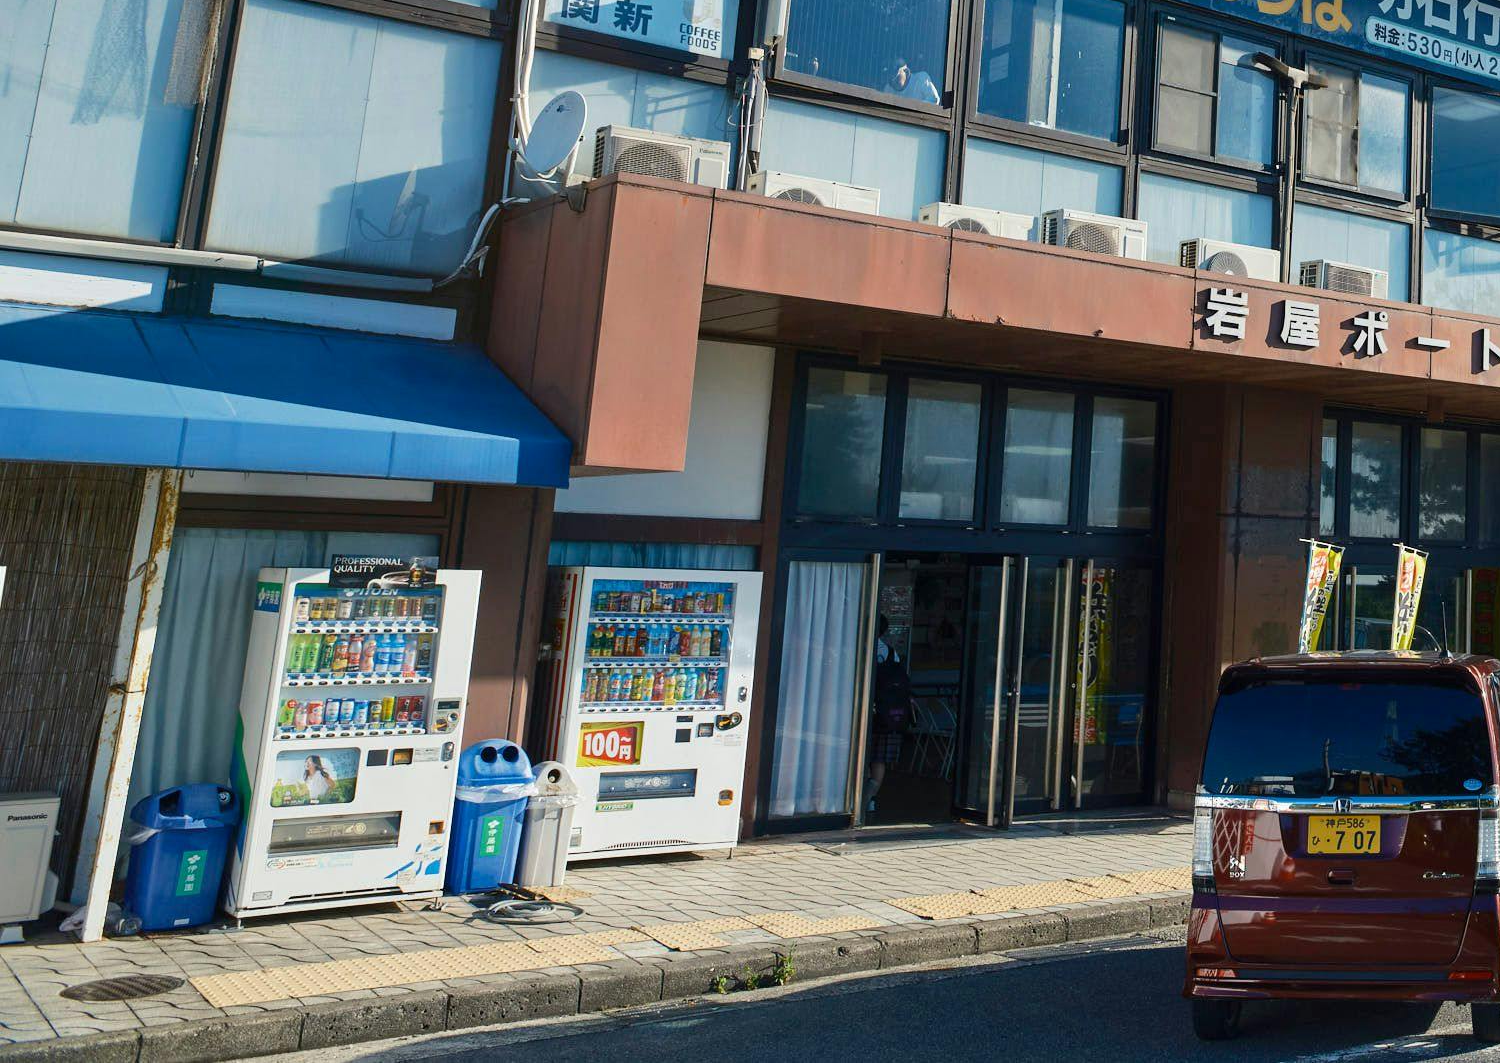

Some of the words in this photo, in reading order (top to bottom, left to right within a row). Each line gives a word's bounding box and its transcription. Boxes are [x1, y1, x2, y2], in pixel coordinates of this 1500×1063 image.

[680, 23, 721, 42] COFFEE
[680, 35, 717, 51] FOODS
[335, 556, 404, 566] PROFESSIONAL
[334, 565, 376, 573] QUALITY
[7, 813, 48, 821] Panasonic
